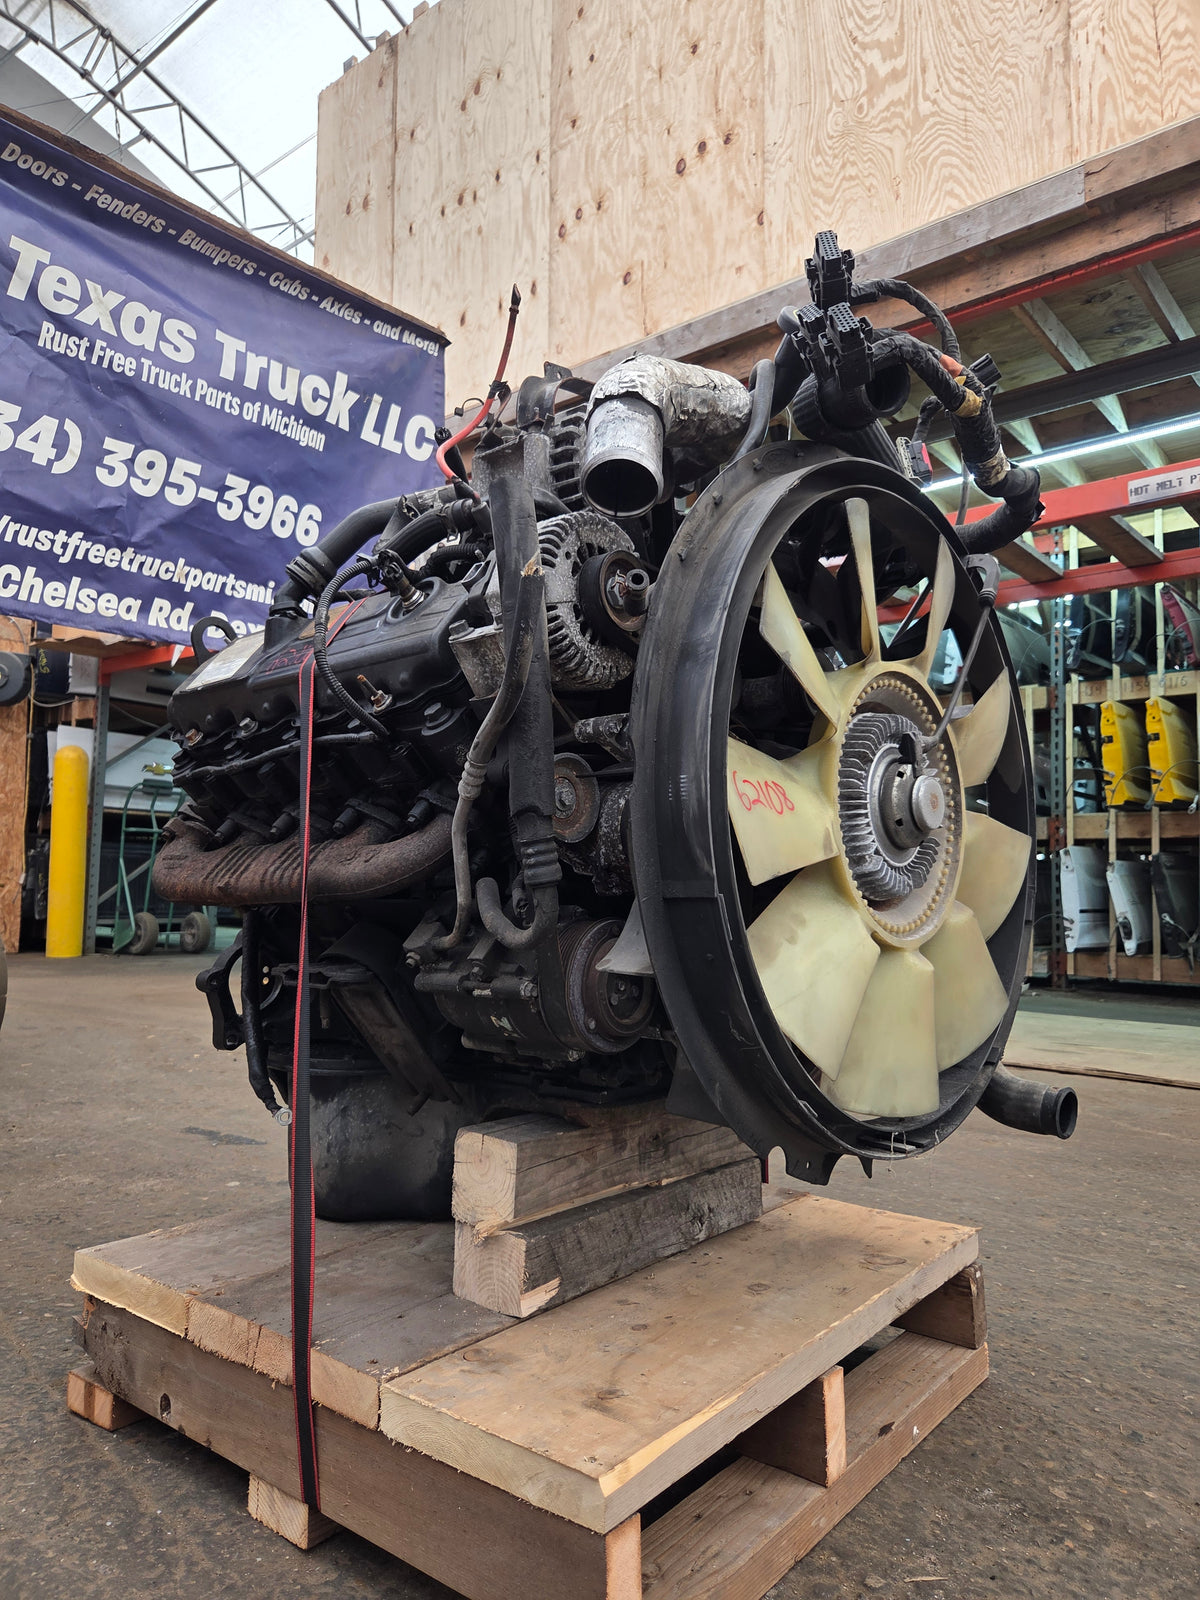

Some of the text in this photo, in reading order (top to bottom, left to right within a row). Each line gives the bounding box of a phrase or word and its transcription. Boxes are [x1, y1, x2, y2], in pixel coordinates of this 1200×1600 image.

[0, 142, 69, 187] Doors
[84, 184, 166, 233] Fenders
[178, 229, 257, 275] Bumpers
[269, 271, 310, 301] Cabs
[319, 296, 363, 325] Axles
[373, 320, 402, 341] and
[402, 330, 440, 357] More!
[6, 234, 437, 462] Texas Truck LLC
[38, 320, 326, 452] Rust Free Truck Parts of Michigan
[95, 436, 322, 547] 395-3966
[1129, 484, 1150, 497] HOT
[1156, 477, 1183, 492] MELT
[0, 564, 142, 622] Chelsea
[732, 770, 795, 815] 62108
